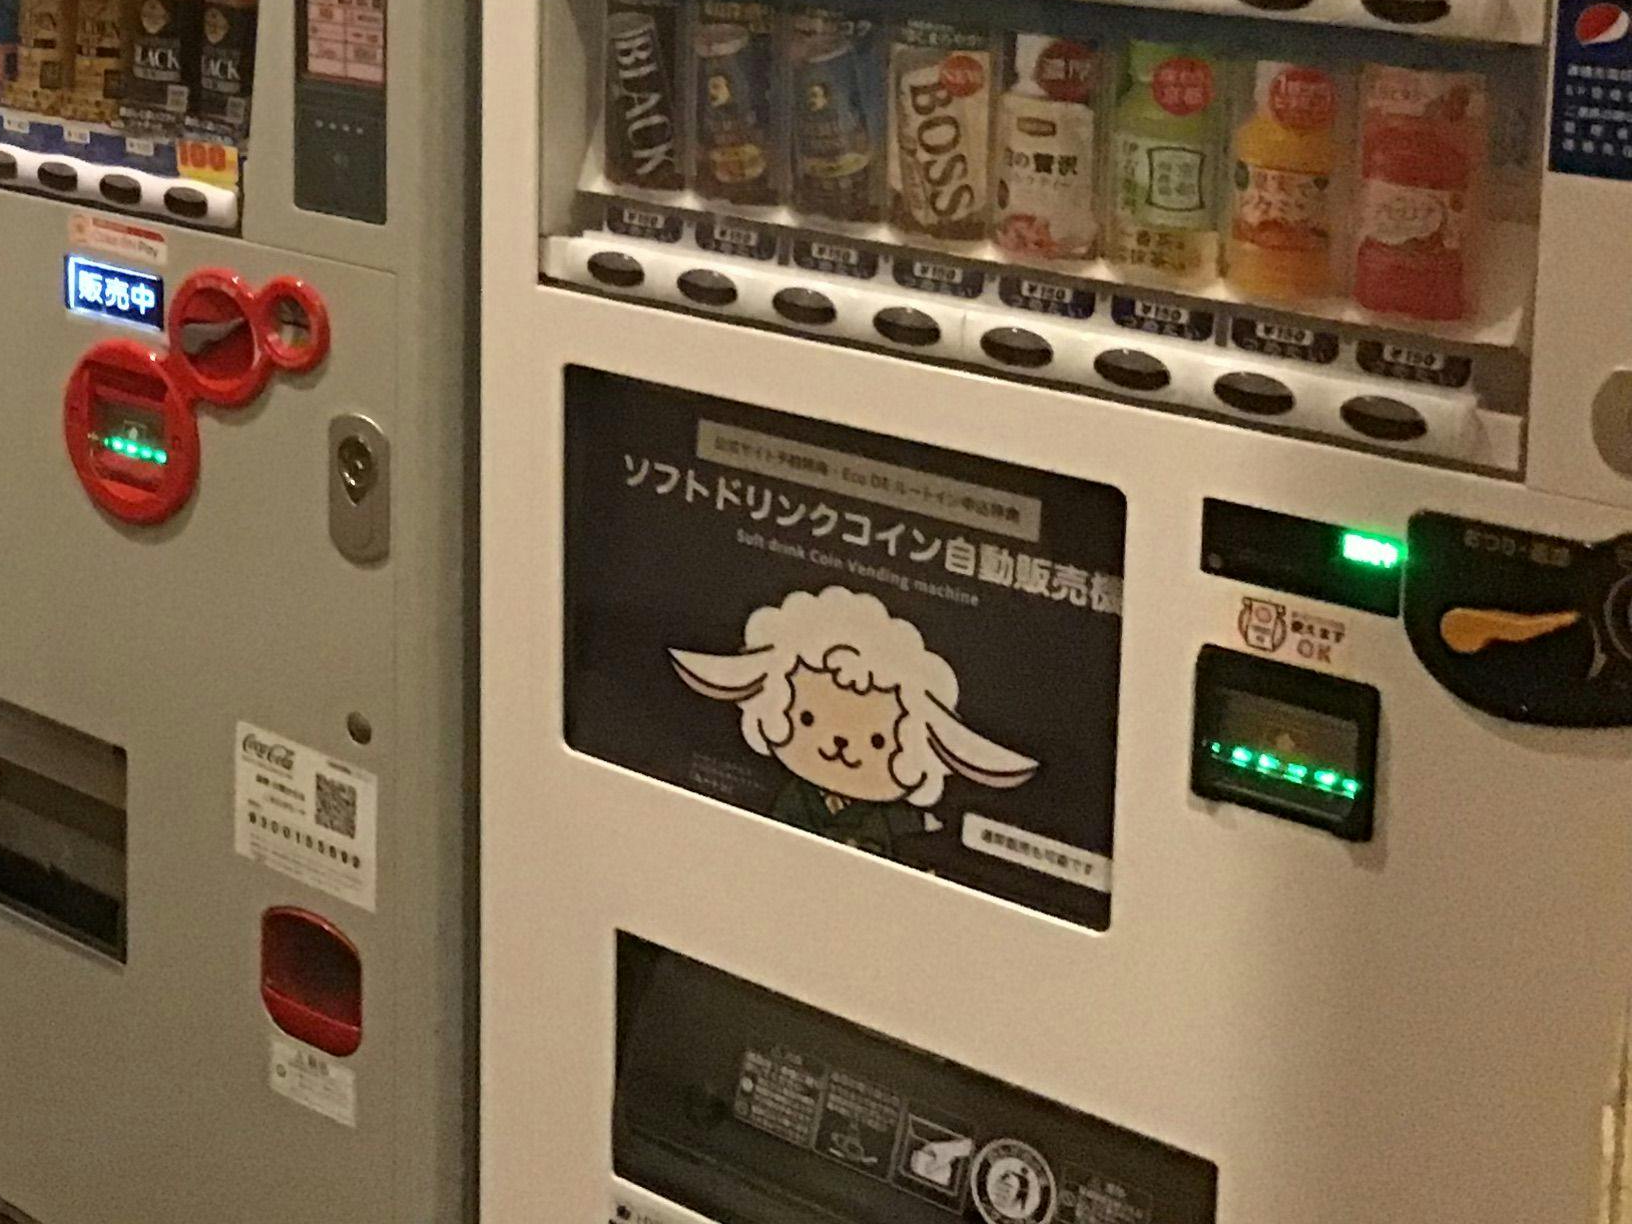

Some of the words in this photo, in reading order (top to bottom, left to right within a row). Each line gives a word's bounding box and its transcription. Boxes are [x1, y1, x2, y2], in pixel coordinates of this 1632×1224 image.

[615, 32, 676, 176] BLACK
[909, 82, 976, 217] BOSS
[78, 269, 155, 315] 販売中
[809, 548, 843, 569] Coin
[848, 558, 909, 592] Vending
[913, 579, 979, 607] machine
[1296, 638, 1332, 664] OK
